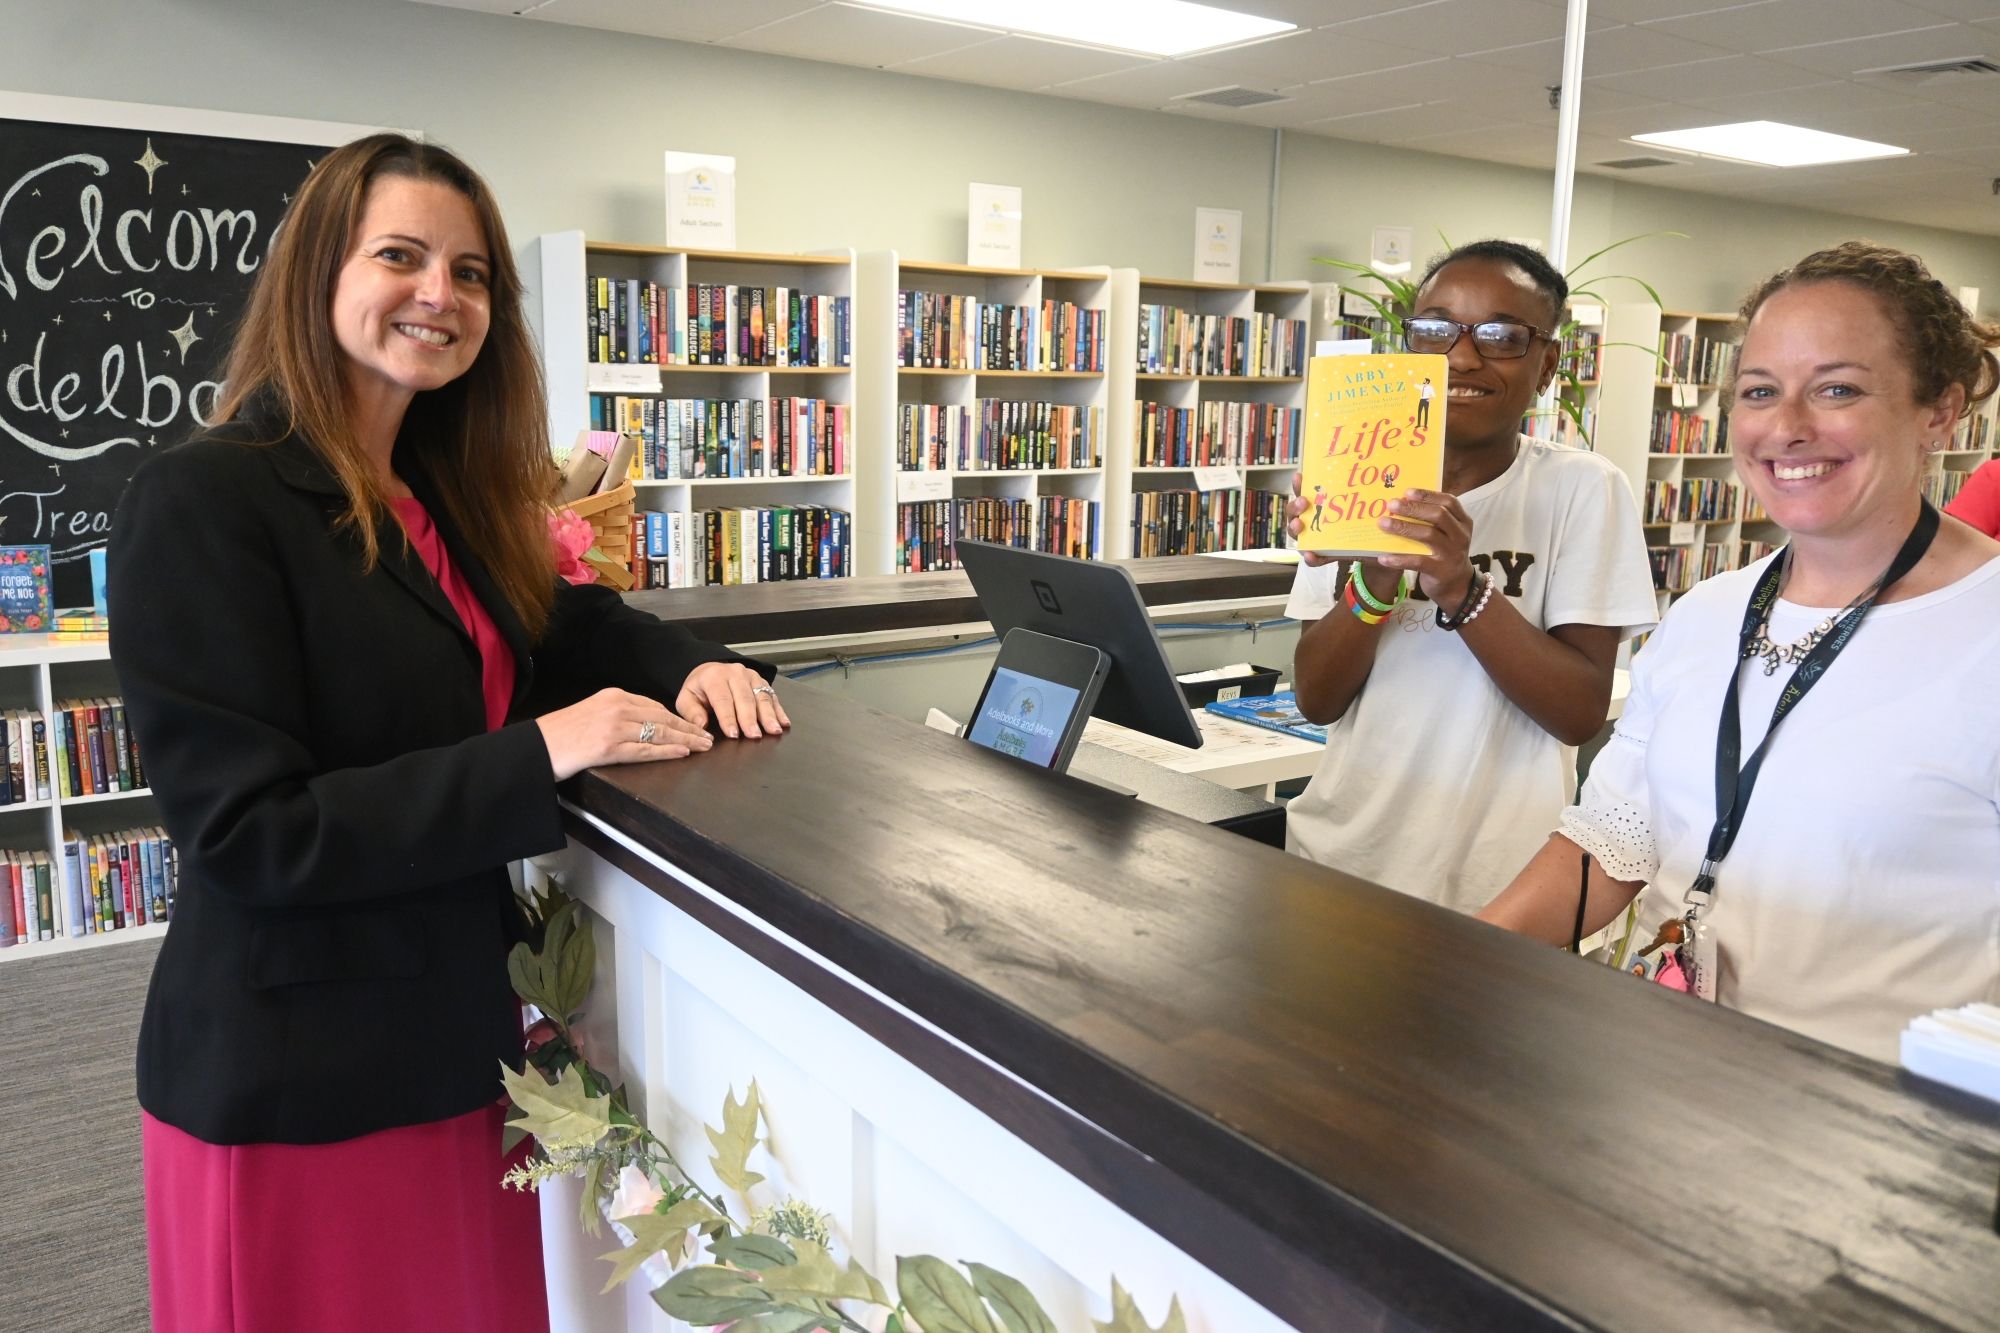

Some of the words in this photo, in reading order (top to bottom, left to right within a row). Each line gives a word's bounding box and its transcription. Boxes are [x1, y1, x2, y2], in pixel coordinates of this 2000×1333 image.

[0, 153, 286, 300] elcom
[122, 288, 155, 309] TO
[688, 318, 698, 354] DEADLOCK
[0, 331, 224, 430] delbo
[1344, 368, 1386, 384] ABBY
[1328, 382, 1406, 402] JIMENEZ
[1324, 416, 1428, 460] Life's
[1347, 462, 1400, 488] too
[1323, 492, 1408, 524] Sho
[635, 519, 645, 535] Tom
[654, 516, 662, 529] TOM
[634, 536, 645, 560] Clancy
[654, 530, 662, 553] CLANCY
[986, 707, 1020, 726] Adelbooks
[1020, 720, 1034, 732] and
[1034, 722, 1054, 738] More
